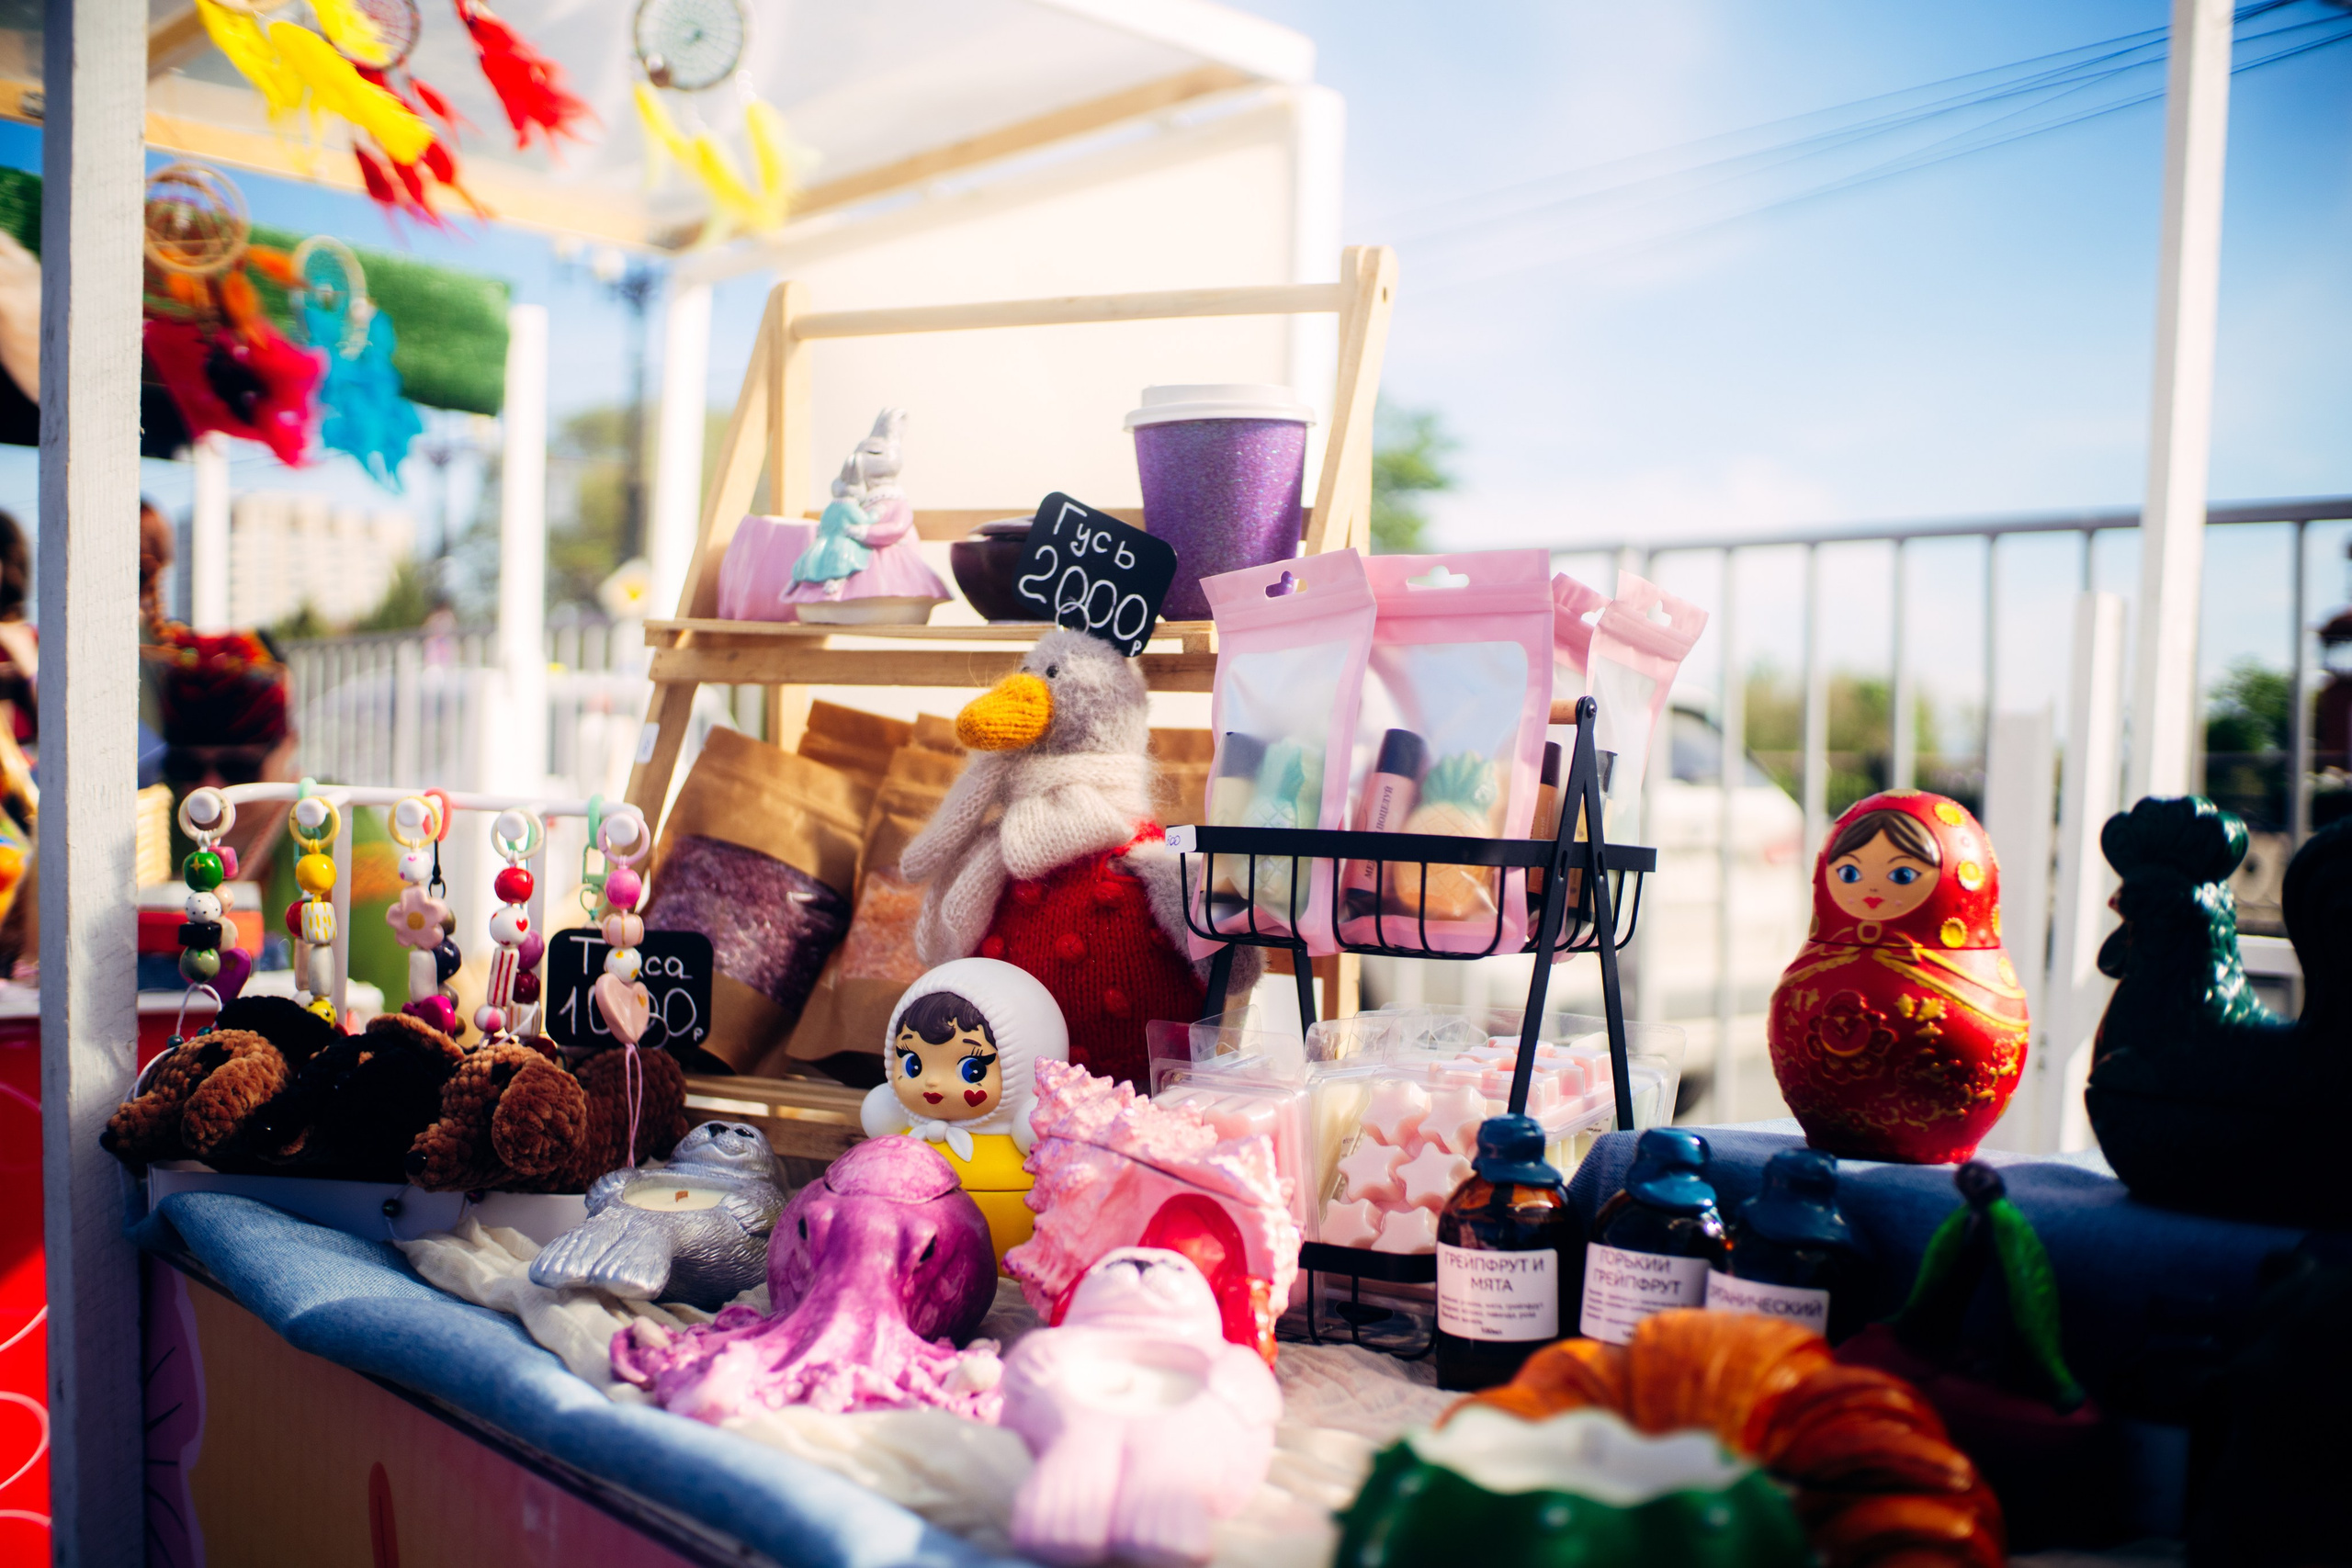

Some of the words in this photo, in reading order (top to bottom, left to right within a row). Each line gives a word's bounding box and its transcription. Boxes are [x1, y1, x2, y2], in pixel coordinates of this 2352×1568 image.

[1053, 501, 1136, 570] Гусь
[1375, 785, 1394, 831] ПОЦЕЛУЙ
[569, 935, 694, 979] Тса
[1444, 1251, 1530, 1273] ГРЕЙПФРУТ
[1532, 1257, 1544, 1272] И
[1470, 1277, 1514, 1292] МЯТА
[1593, 1267, 1682, 1295] ГРЕЙПФРУТ
